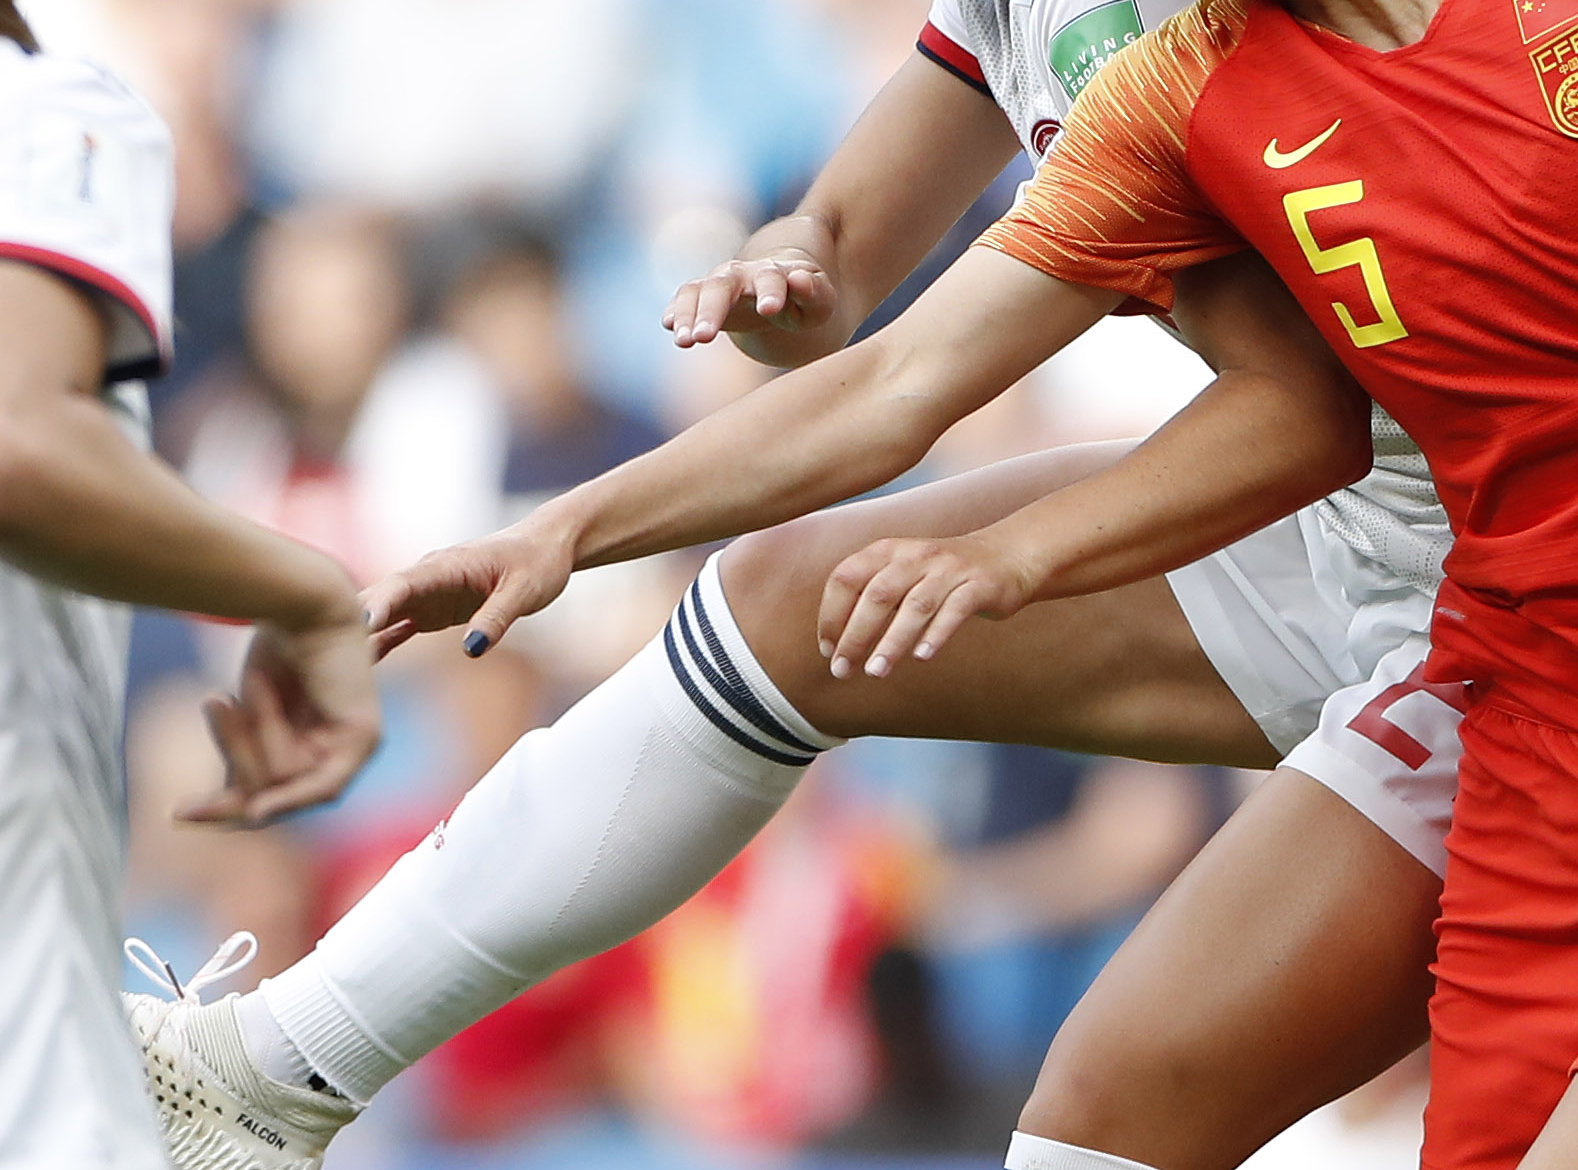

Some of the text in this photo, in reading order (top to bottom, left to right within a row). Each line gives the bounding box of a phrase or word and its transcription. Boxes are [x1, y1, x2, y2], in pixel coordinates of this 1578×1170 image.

[1063, 32, 1136, 82] LIVING
[1069, 52, 1115, 94] FOOTBA
[1282, 179, 1409, 348] 5
[235, 1113, 288, 1152] FALCÓN
